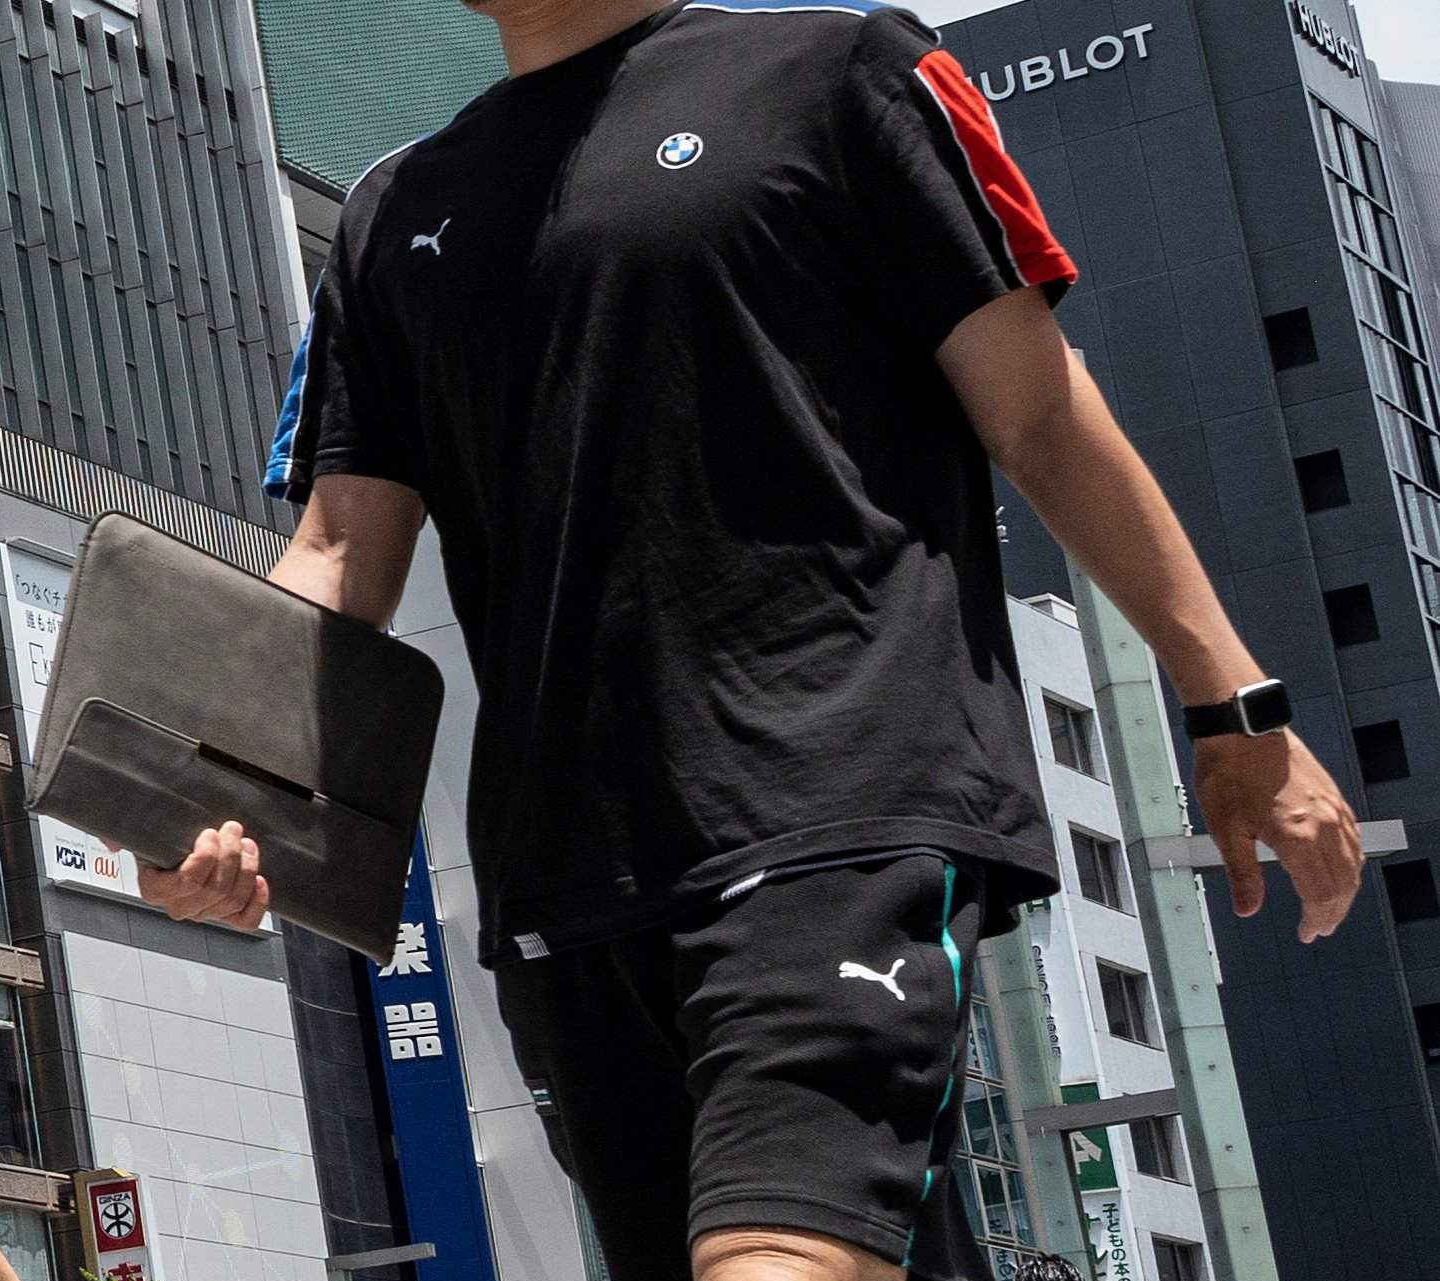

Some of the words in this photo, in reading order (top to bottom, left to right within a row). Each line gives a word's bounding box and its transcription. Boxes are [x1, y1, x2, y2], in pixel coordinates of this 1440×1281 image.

[1292, 0, 1361, 78] HUBLOT
[966, 23, 1153, 102] UBLOT
[15, 574, 69, 607] 「つなぐチ
[26, 609, 62, 634] 誰もが
[56, 845, 86, 871] KDDI
[94, 857, 120, 879] au
[376, 922, 443, 1060] 楽器
[98, 1193, 131, 1205] GINZA
